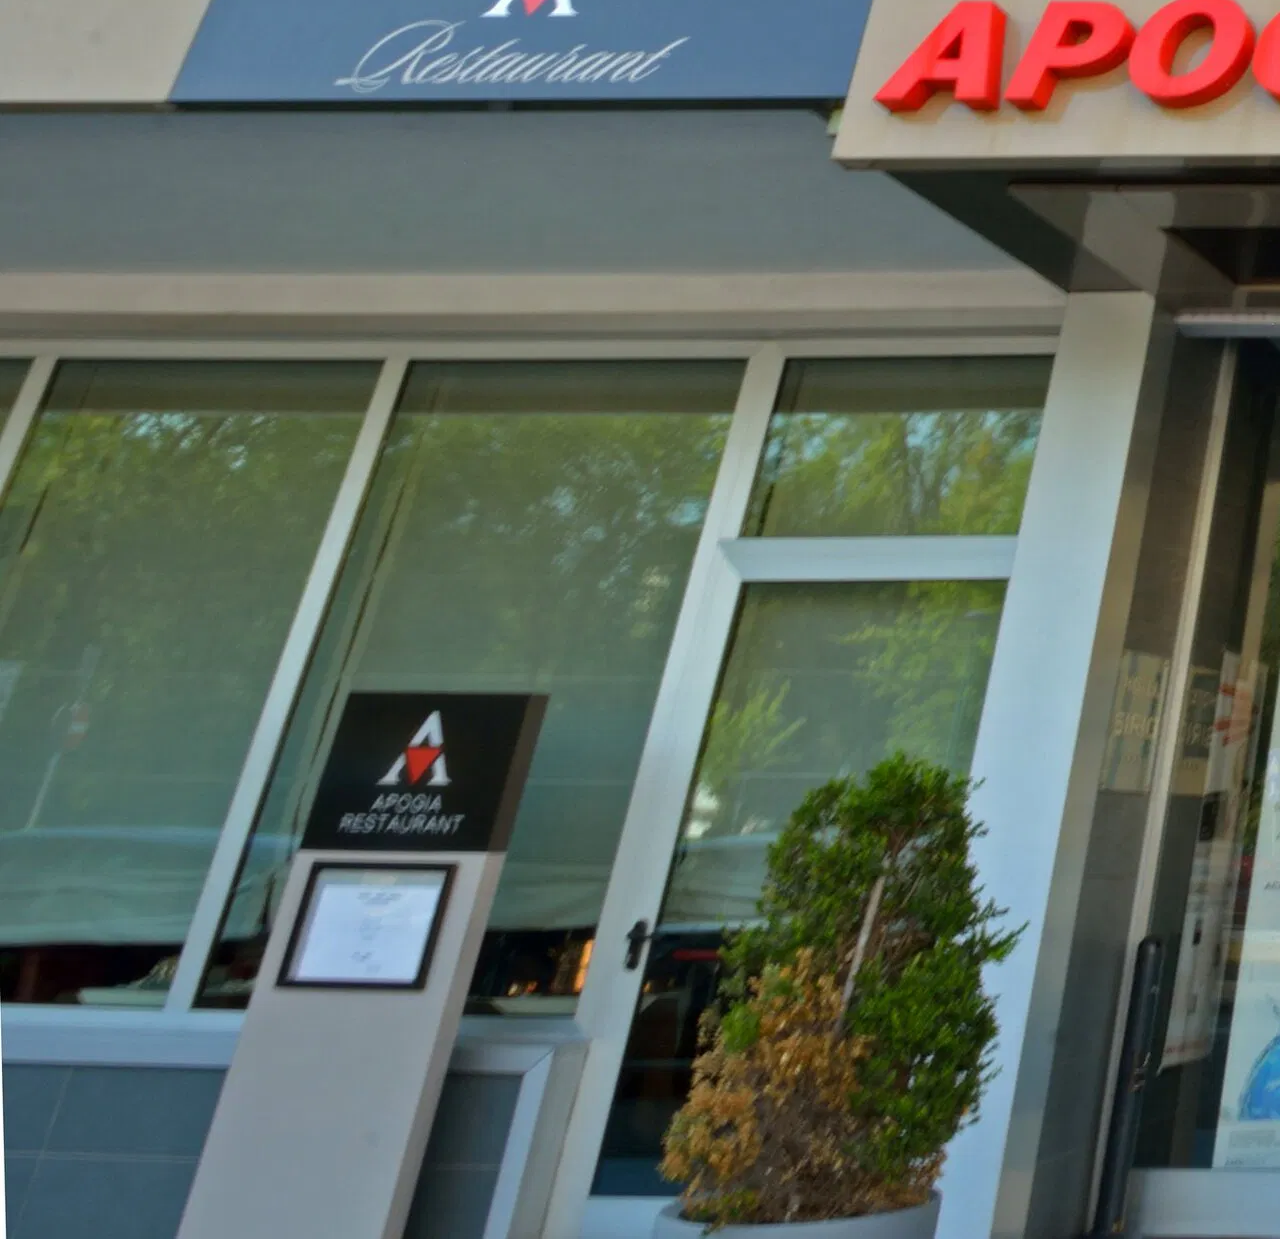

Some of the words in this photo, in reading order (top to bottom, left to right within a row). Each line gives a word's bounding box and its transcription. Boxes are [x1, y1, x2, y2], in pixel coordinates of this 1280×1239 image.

[333, 19, 691, 93] Restaurant
[370, 793, 442, 813] APOGIA
[337, 813, 466, 835] RESTAURANT
